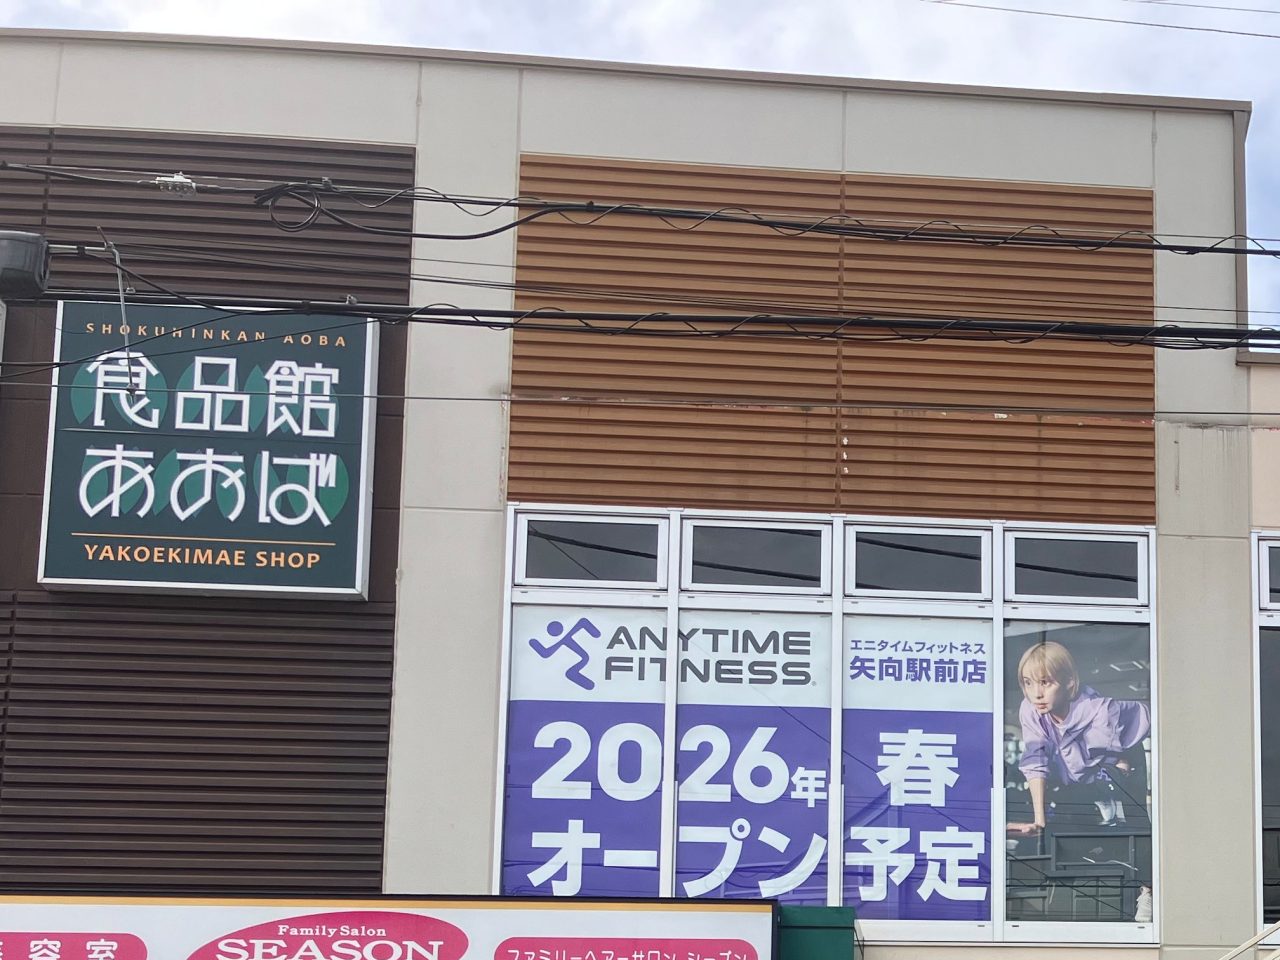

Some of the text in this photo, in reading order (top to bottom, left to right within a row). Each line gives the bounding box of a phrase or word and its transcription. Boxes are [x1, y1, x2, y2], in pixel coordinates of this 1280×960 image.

[86, 322, 347, 347] SHOKUHINKAN AOBA
[86, 350, 340, 438] 食品館
[79, 444, 337, 527] あおば
[84, 544, 321, 569] YAKOEKIMAE SHOP
[607, 625, 811, 655] ANYTIME
[850, 638, 986, 656] エニタイムフィットネス
[604, 655, 812, 686] FITNESS
[849, 655, 987, 685] 矢向駅前店
[531, 721, 960, 807] 2026年 春
[278, 923, 386, 939] Family Salon
